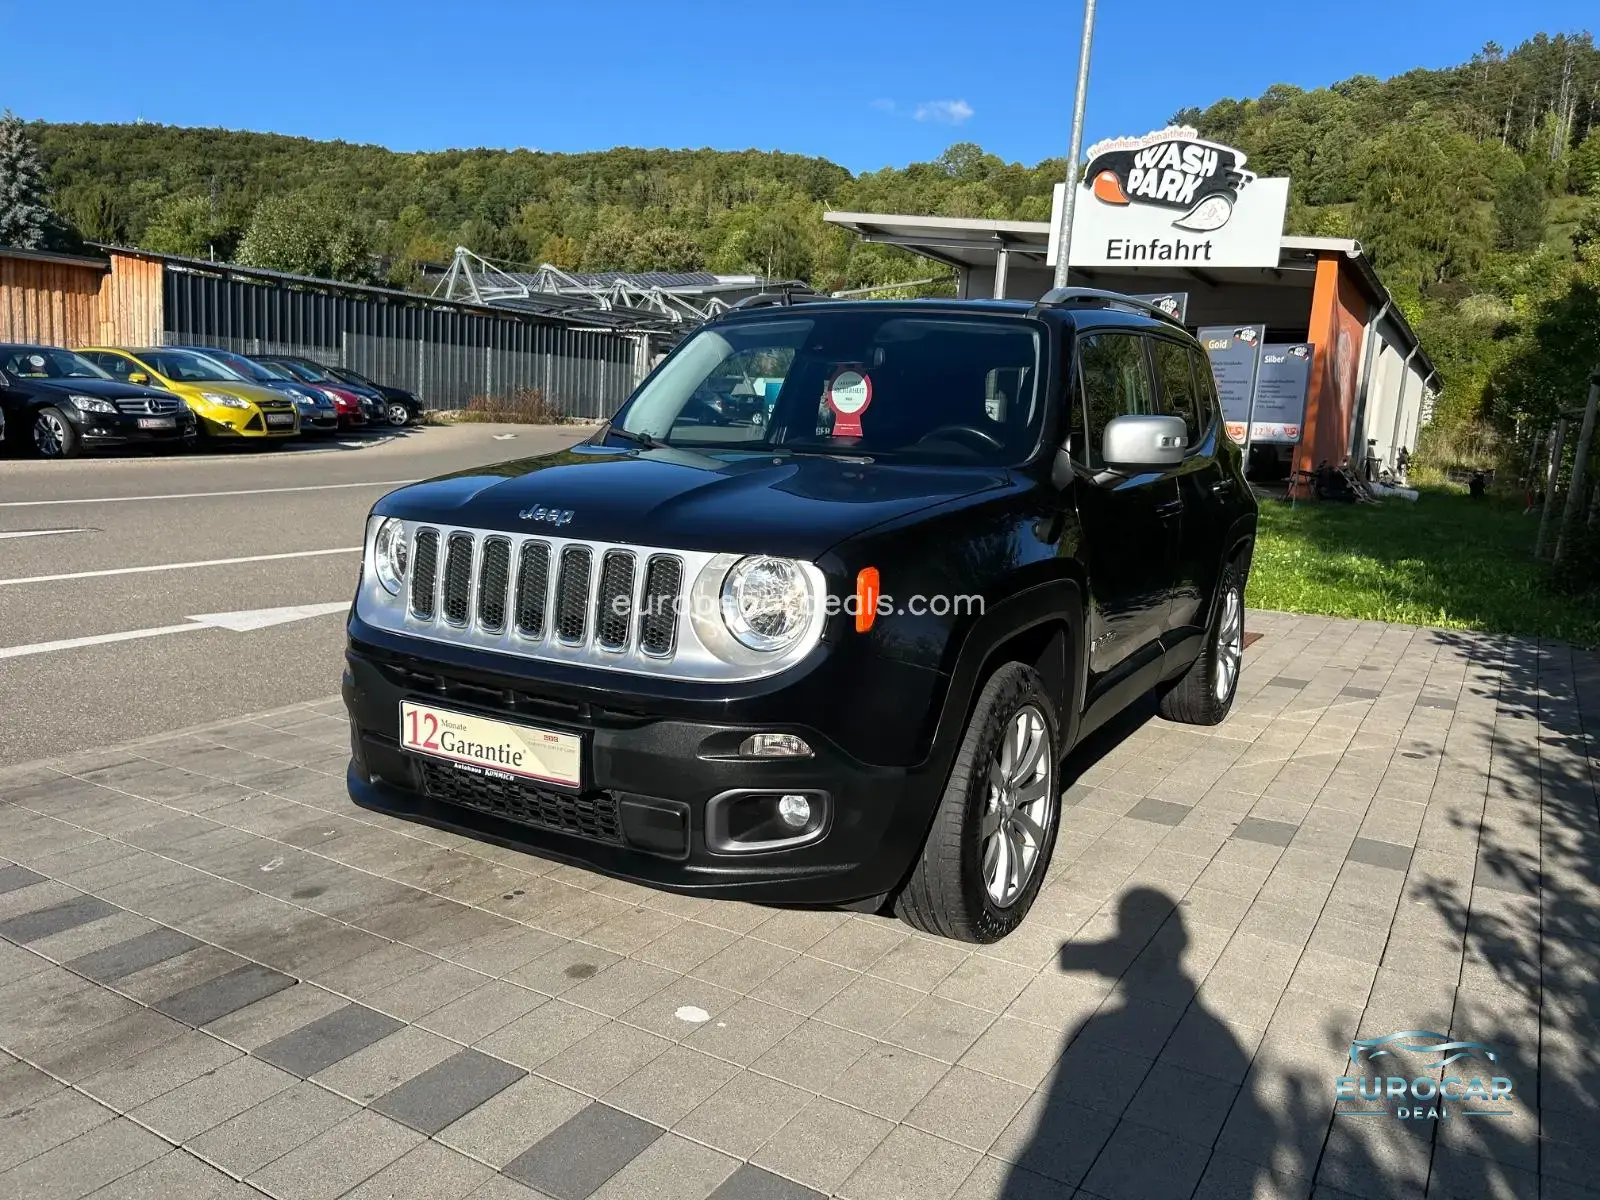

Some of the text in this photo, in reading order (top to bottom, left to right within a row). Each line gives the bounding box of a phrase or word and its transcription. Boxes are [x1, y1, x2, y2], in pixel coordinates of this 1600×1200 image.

[1141, 129, 1196, 146] Schnaitheim
[1134, 142, 1218, 177] WASH
[1126, 168, 1203, 204] PARK
[1106, 238, 1212, 261] Einfahrt
[1208, 339, 1228, 349] Gold
[1263, 355, 1285, 364] Silber
[518, 503, 575, 527] Jeep
[406, 709, 440, 751] 12
[441, 718, 467, 732] Monate
[440, 731, 523, 767] Garantie
